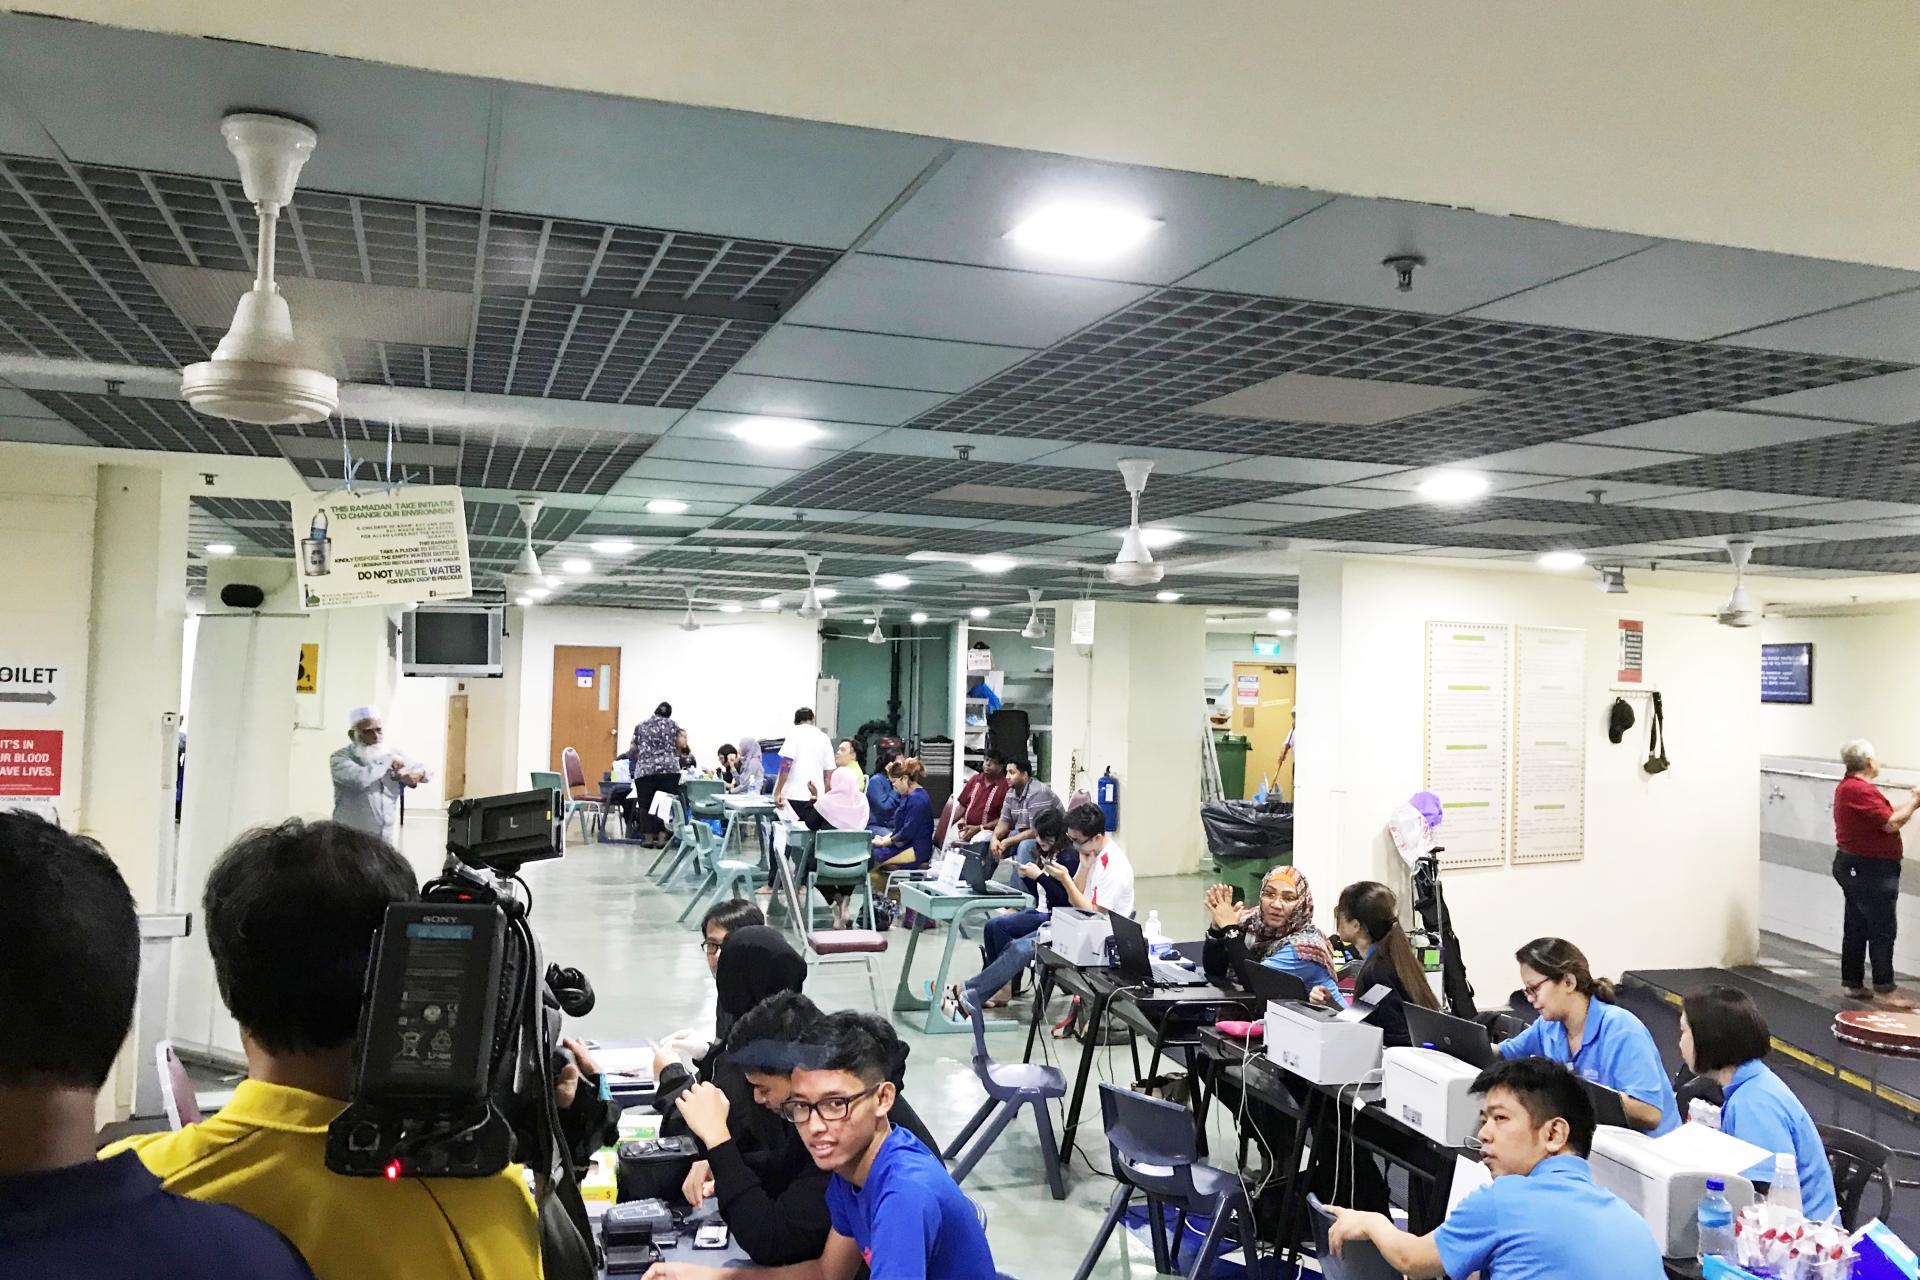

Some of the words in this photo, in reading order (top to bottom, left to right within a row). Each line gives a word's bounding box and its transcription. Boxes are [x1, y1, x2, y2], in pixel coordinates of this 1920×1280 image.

[348, 511, 381, 520] CHANGE
[358, 571, 372, 580] DO
[374, 570, 393, 579] NOT
[394, 567, 428, 578] WASTE
[428, 565, 462, 576] WATER
[0, 666, 58, 683] OILET
[0, 740, 20, 750] IT'S
[22, 739, 34, 750] IN
[14, 752, 50, 763] BLOOD
[22, 766, 54, 776] LIVES.
[422, 916, 458, 924] SONY
